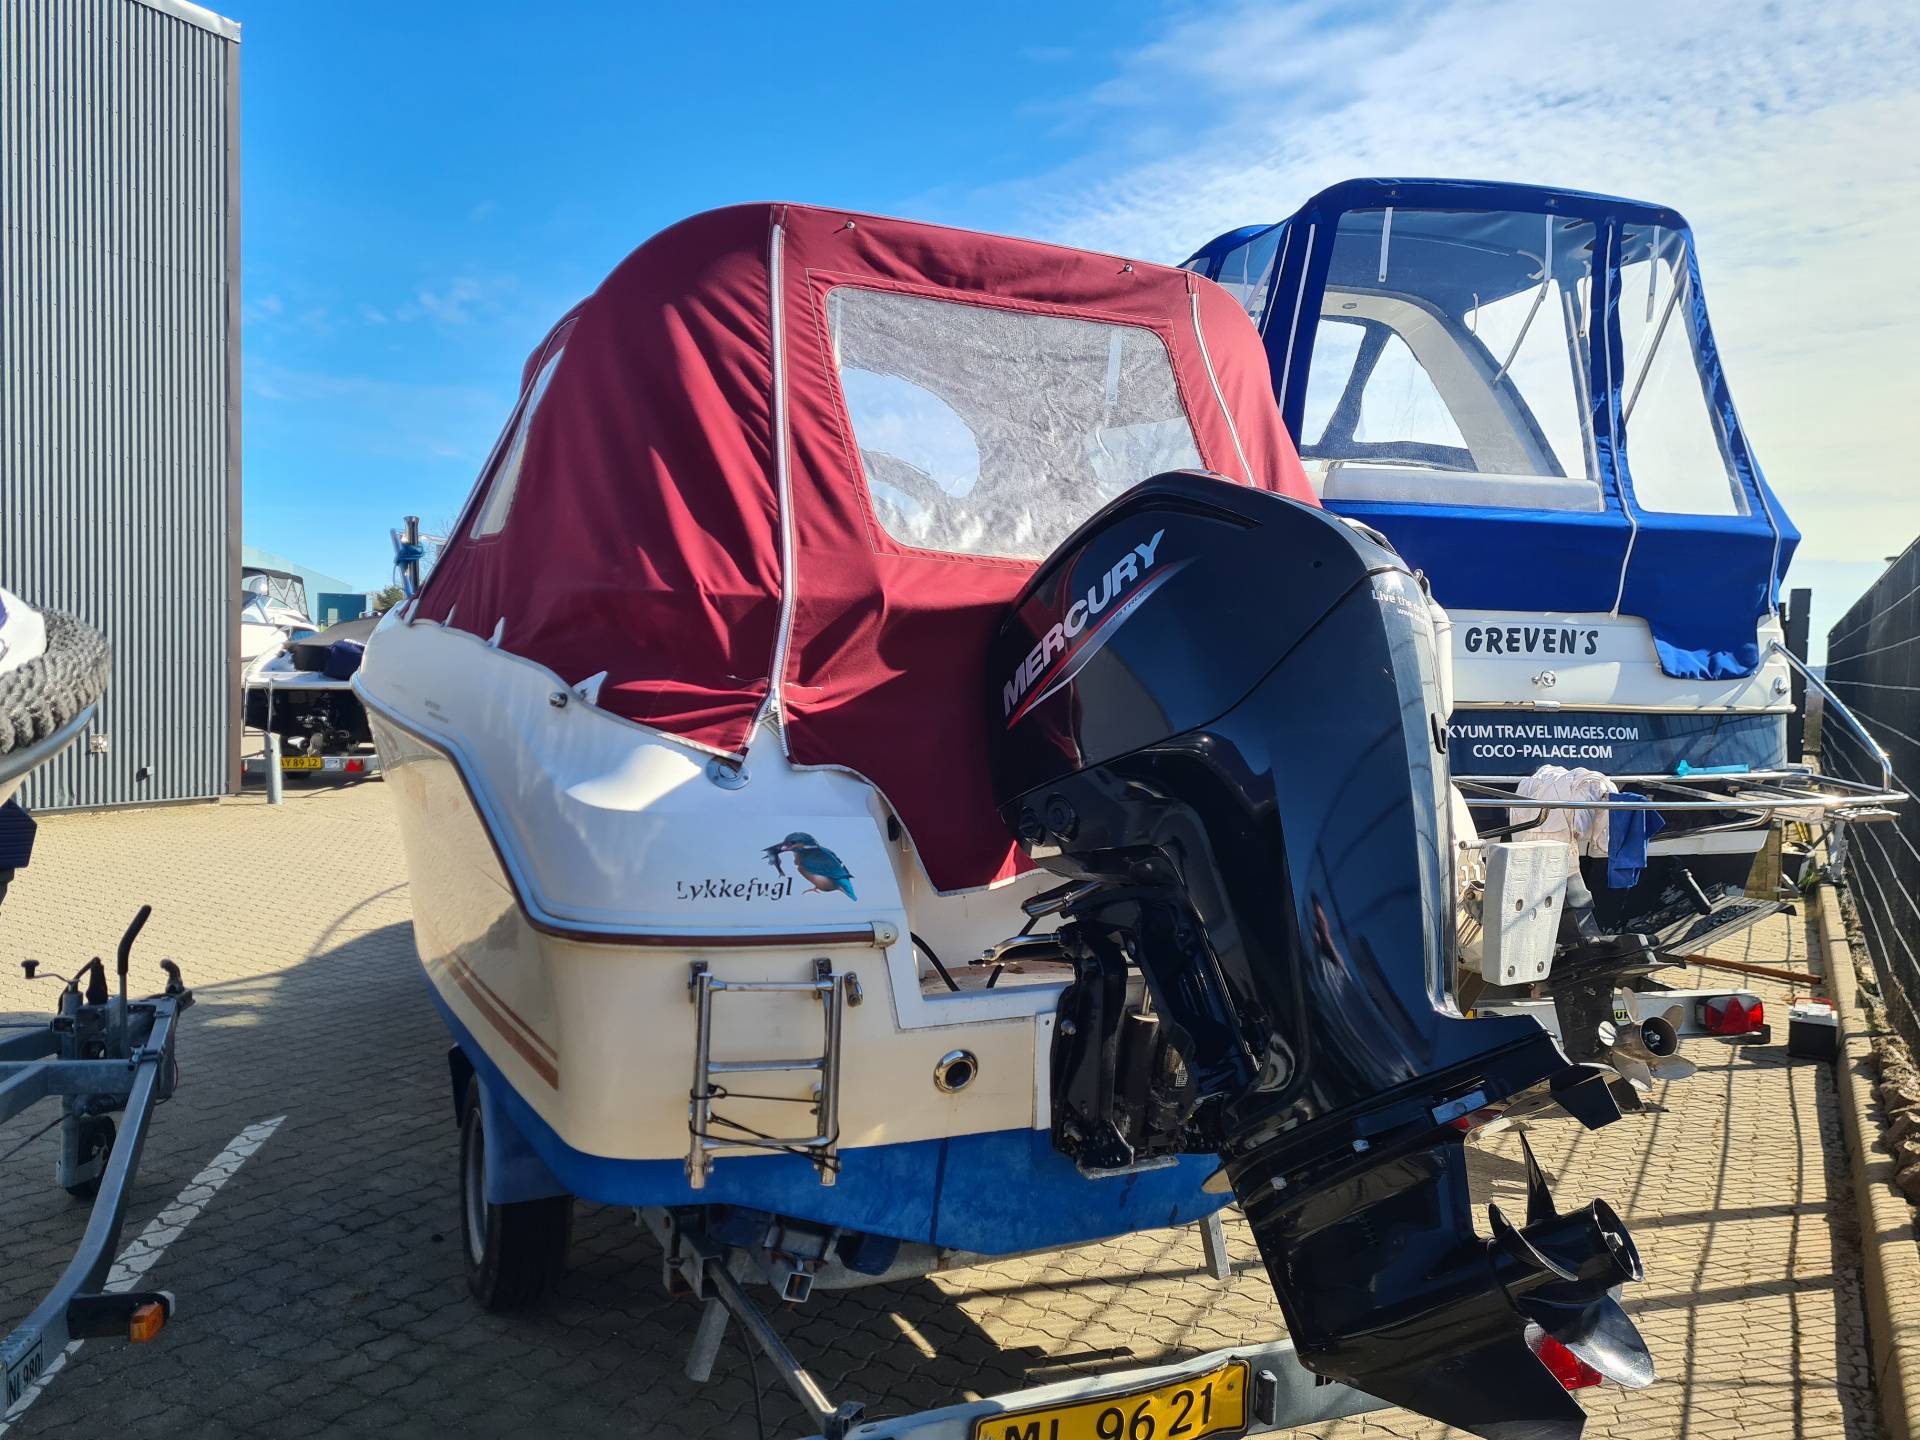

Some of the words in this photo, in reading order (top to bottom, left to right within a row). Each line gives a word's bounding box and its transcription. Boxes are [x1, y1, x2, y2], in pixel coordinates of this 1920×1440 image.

[1371, 590, 1396, 603] Live
[1002, 528, 1165, 716] MERCURY
[1464, 626, 1599, 655] GREVEN'S
[1495, 725, 1552, 739] TRAVEL
[1553, 726, 1639, 741] IMAGES.COM
[1472, 744, 1613, 759] COCO-PALACE.COM
[676, 876, 793, 902] Lykkefugl
